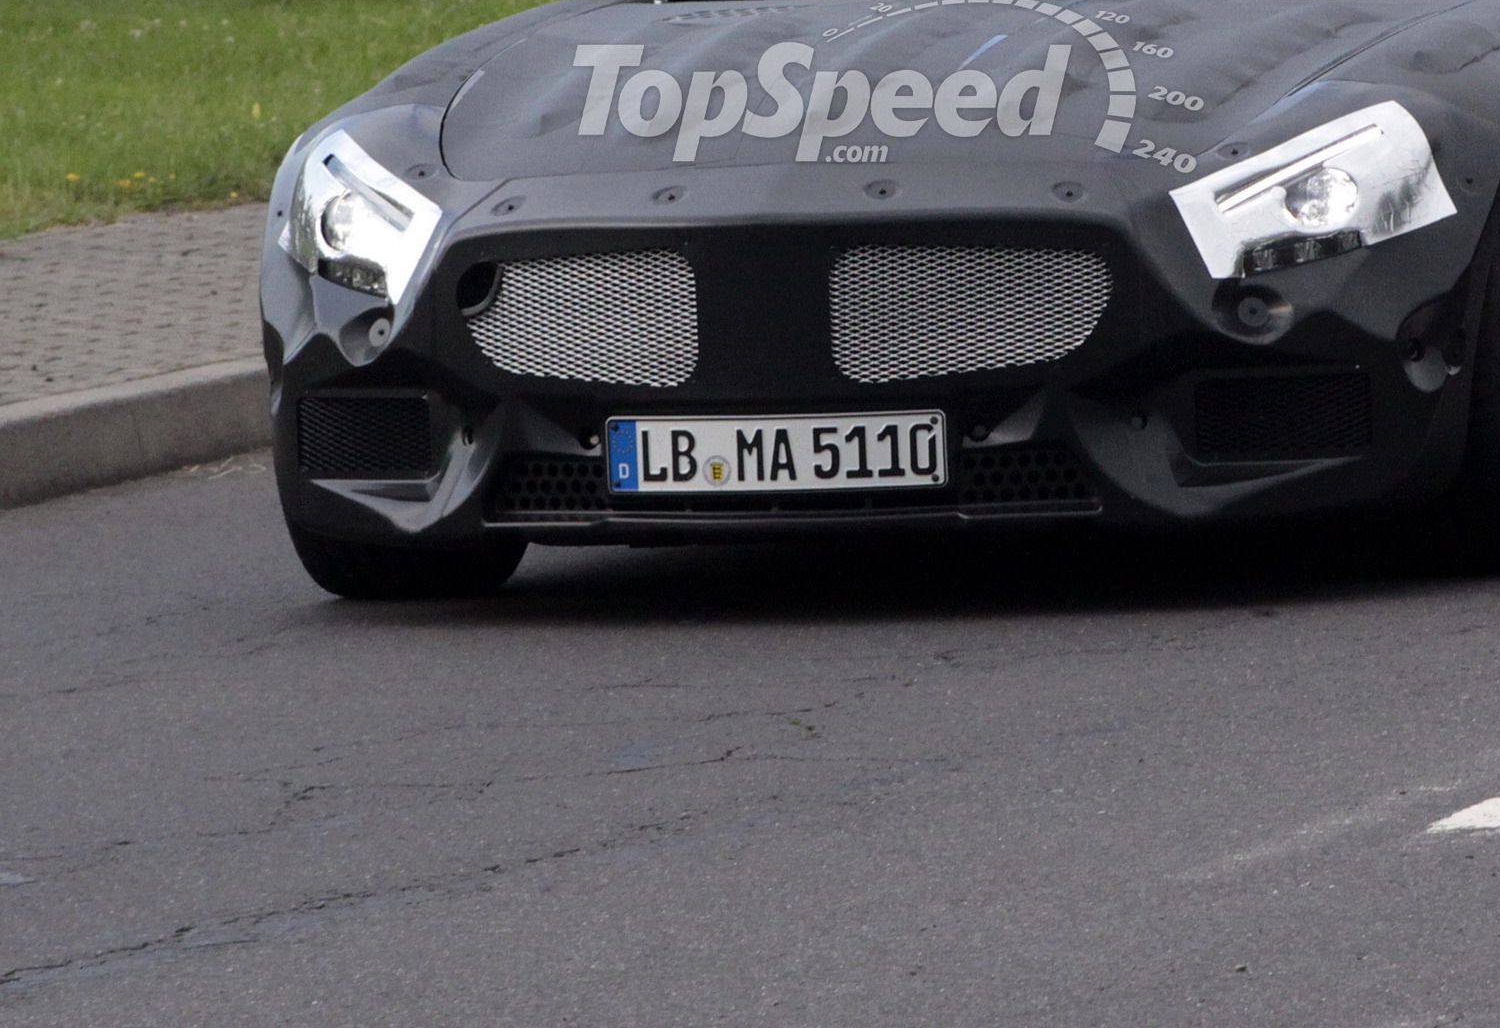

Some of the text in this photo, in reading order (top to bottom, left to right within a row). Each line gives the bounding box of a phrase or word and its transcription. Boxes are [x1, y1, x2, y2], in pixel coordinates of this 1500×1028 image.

[618, 423, 938, 482] D LB MA 5110
